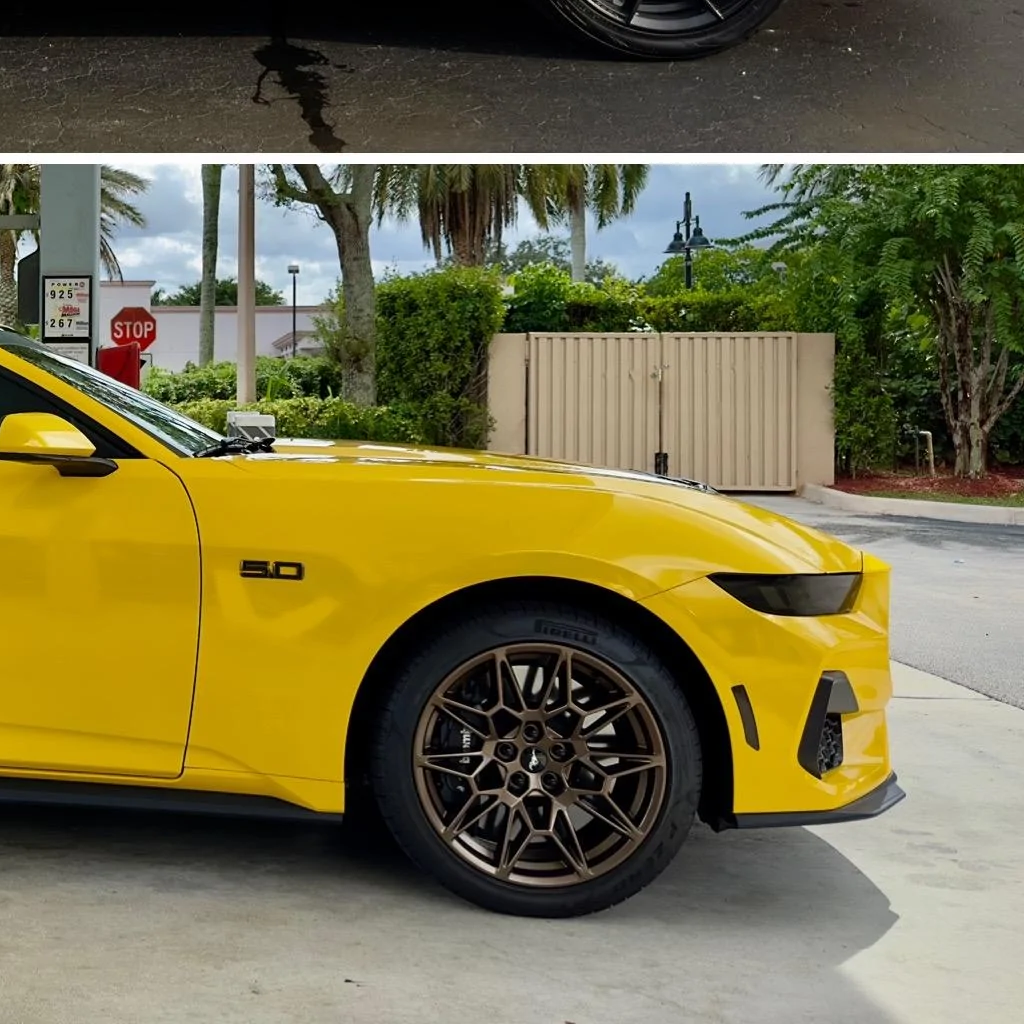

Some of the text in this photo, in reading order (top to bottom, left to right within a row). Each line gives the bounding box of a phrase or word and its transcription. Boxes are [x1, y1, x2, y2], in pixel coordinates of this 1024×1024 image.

[49, 289, 74, 299] 925
[49, 318, 73, 328] 267
[113, 321, 154, 339] STOP
[240, 560, 304, 581] 5.0
